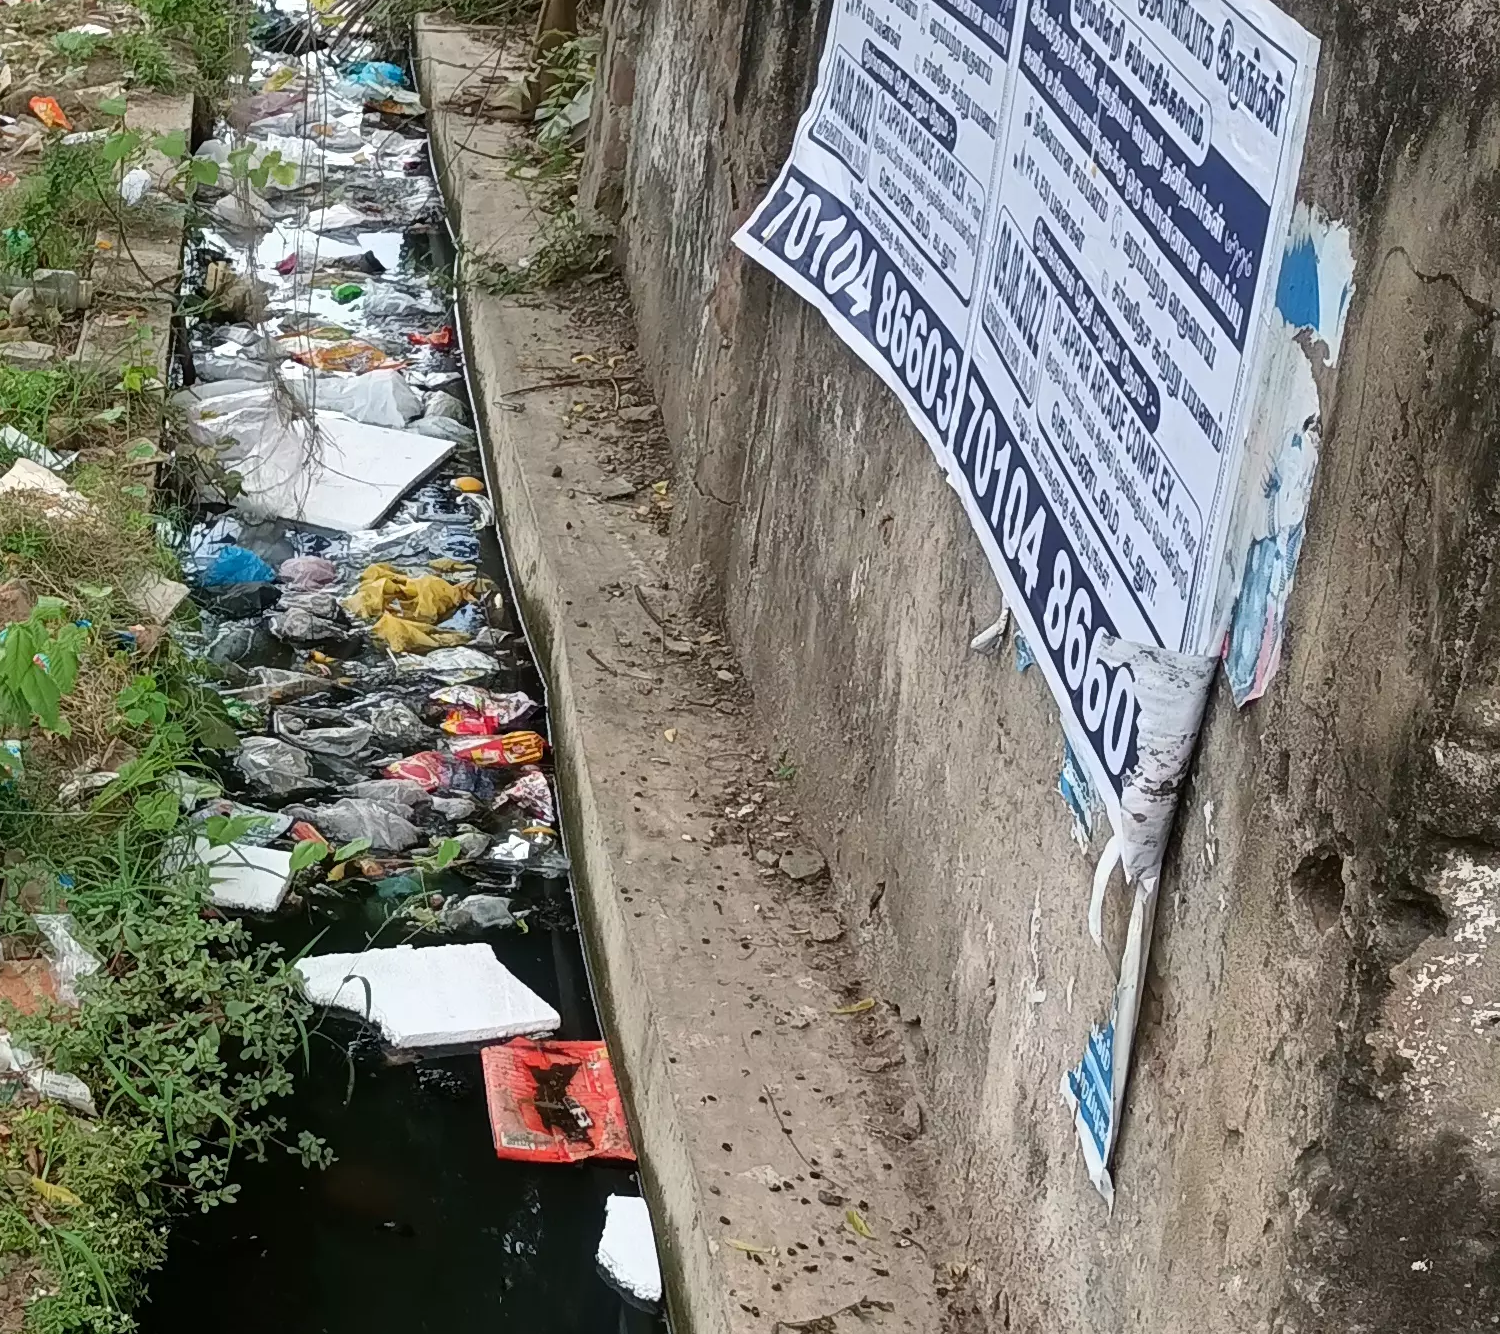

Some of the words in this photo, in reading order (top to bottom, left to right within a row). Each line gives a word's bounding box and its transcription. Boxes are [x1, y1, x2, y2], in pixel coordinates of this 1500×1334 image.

[1216, 18, 1285, 137] இருங்கள்
[933, 148, 967, 205] COMPLEX
[1132, 115, 1163, 170] பெறும்
[1160, 156, 1225, 243] தனிநபர்கள்
[761, 176, 878, 317] 70104
[875, 271, 957, 432] 86603
[994, 221, 1047, 360] 09.08.2022
[1123, 231, 1168, 310] வரம்பற்ற
[1168, 292, 1216, 371] வருவாய்
[1125, 168, 1143, 210] ஒரு
[1143, 188, 1200, 276] பொன்னான
[1200, 262, 1243, 339] வாய்ப்பு
[1089, 362, 1128, 443] ARCADE
[1126, 416, 1175, 518] COMPLEX
[961, 376, 1046, 598] 70104
[1043, 549, 1135, 776] 8660
